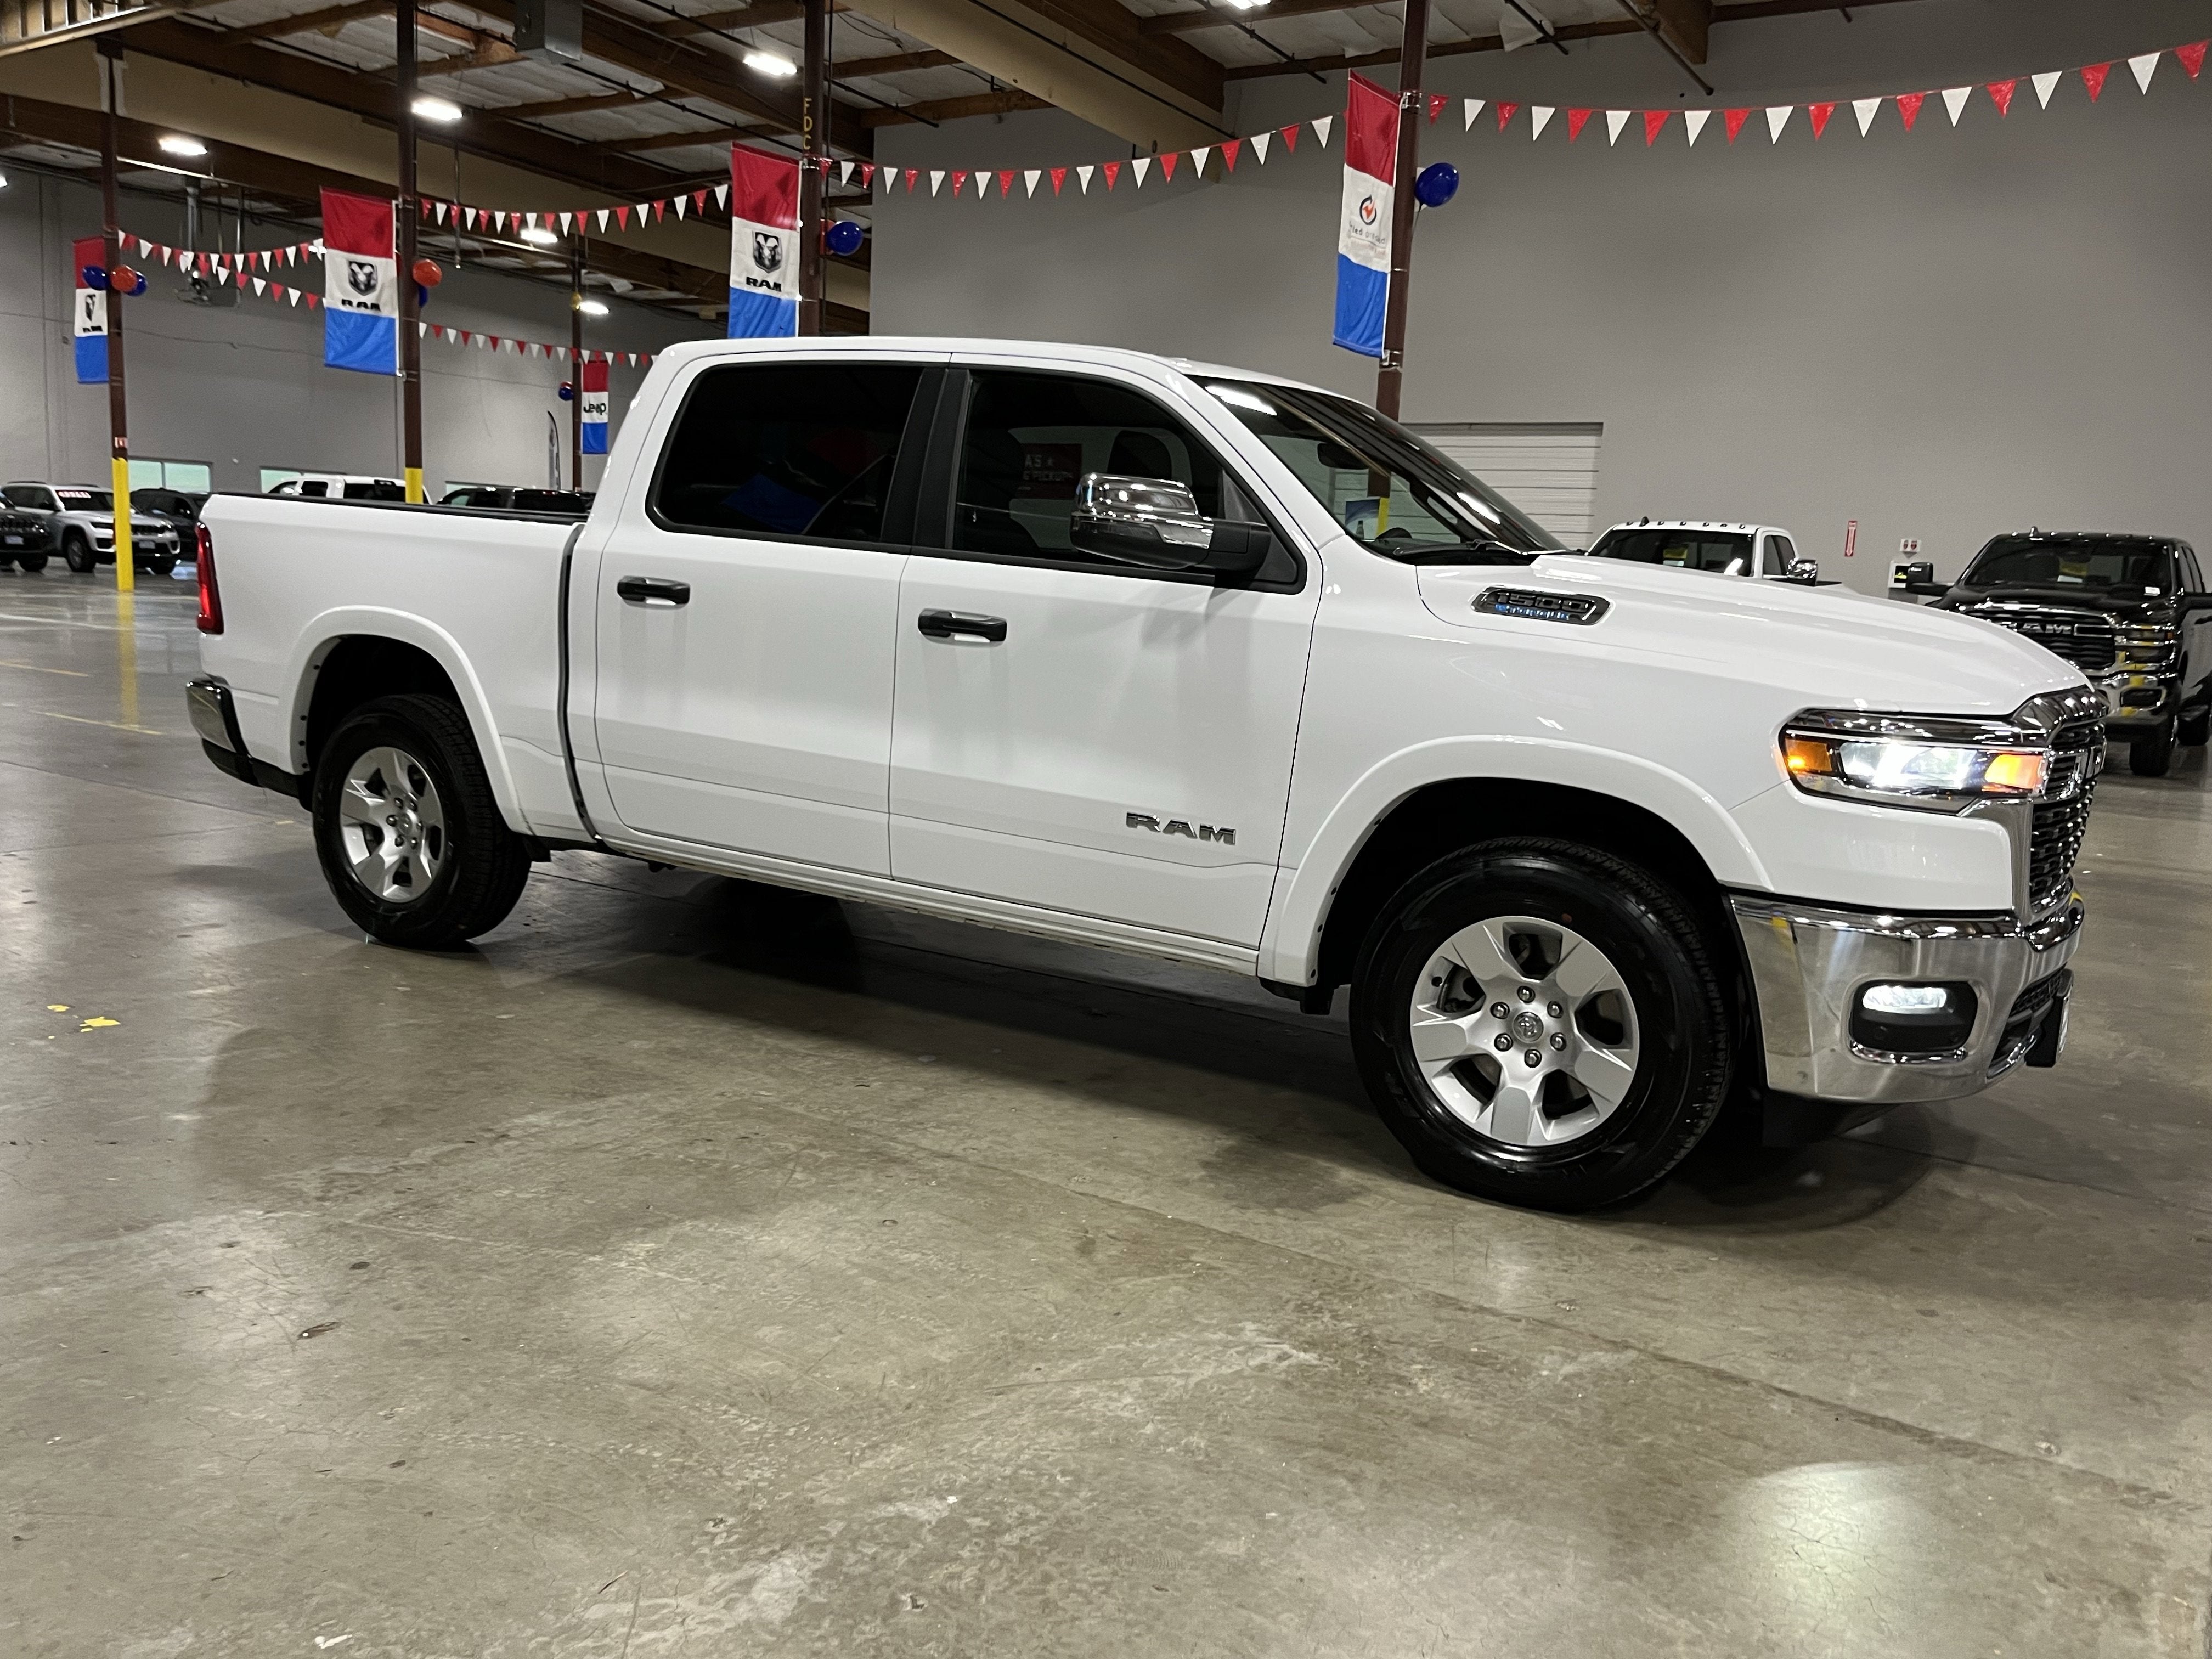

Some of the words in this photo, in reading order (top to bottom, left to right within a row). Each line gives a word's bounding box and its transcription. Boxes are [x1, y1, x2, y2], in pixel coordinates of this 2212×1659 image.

[803, 97, 813, 150] FDC
[746, 276, 782, 292] RAM
[1497, 592, 1592, 613] 1500
[1126, 812, 1236, 845] RAM
